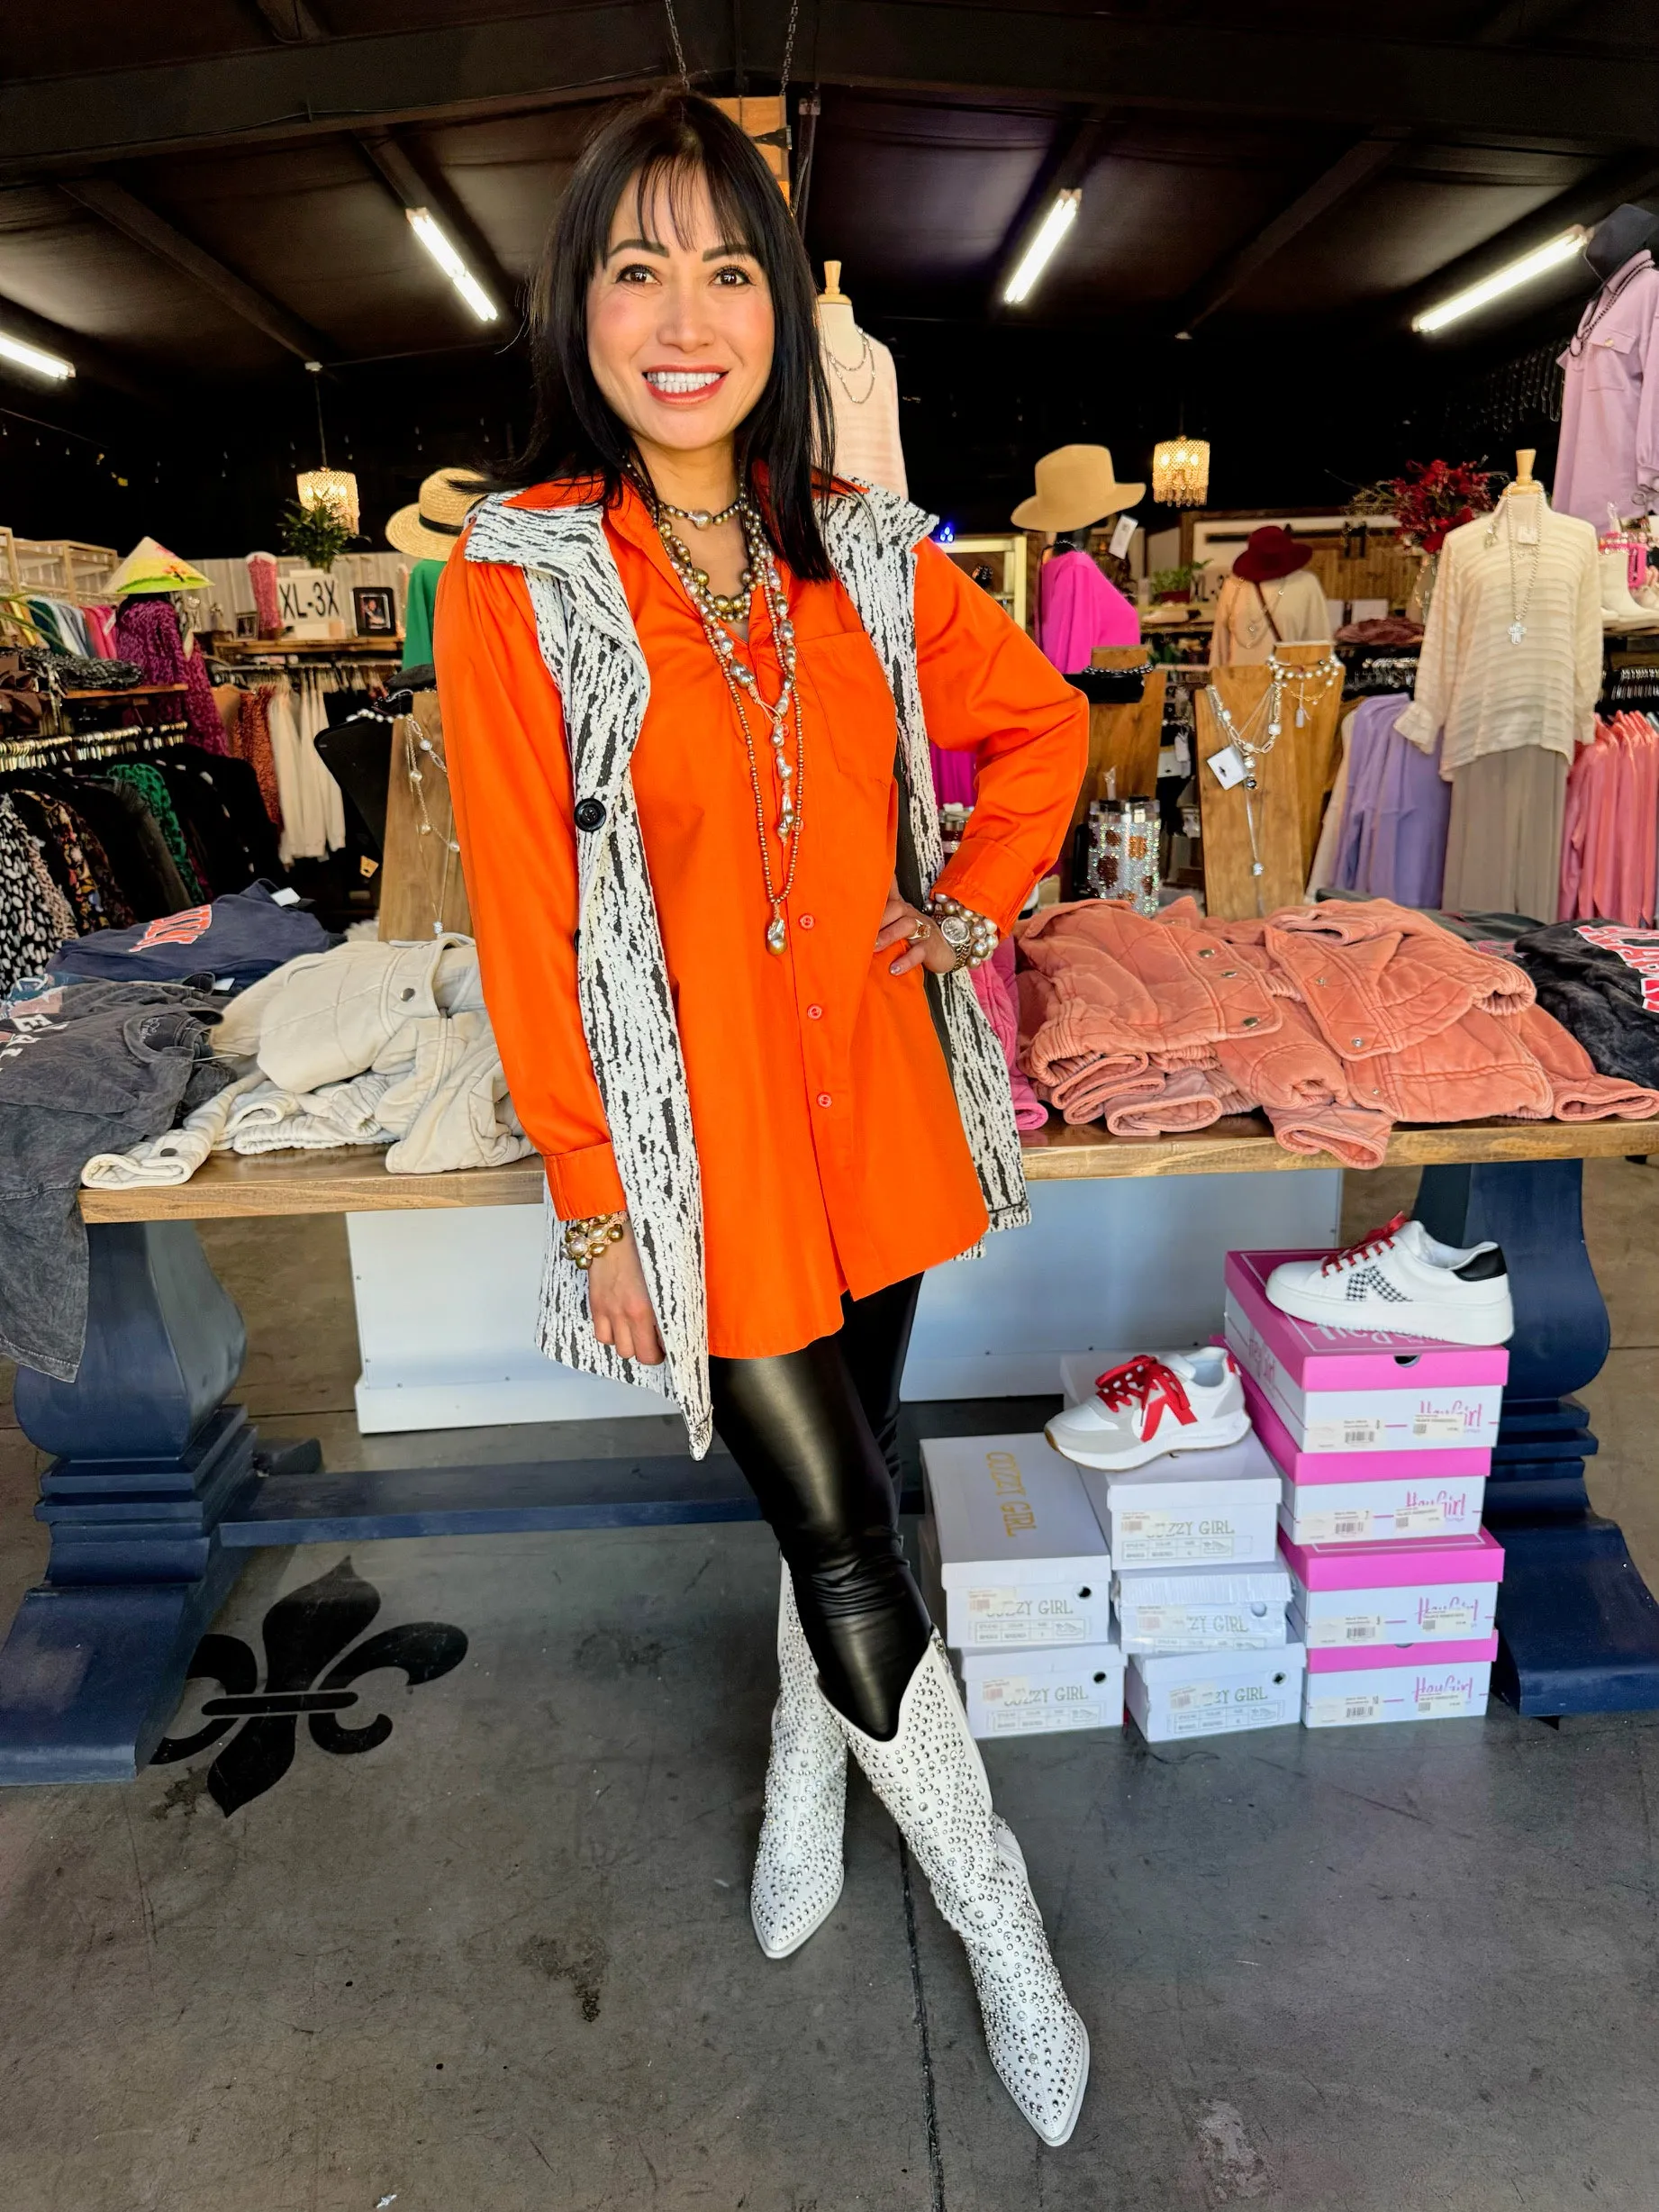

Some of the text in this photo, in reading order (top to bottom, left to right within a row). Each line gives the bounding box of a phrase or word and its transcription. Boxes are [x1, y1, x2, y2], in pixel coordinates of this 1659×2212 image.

[279, 579, 340, 620] XL-3X
[1001, 1500, 1037, 1537] GIRL
[1199, 1519, 1235, 1535] GIRL
[1038, 1600, 1074, 1615] GIRL
[1213, 1614, 1250, 1633] GIRL
[1055, 1685, 1088, 1702] GIRL
[1235, 1686, 1268, 1702] GIRL
